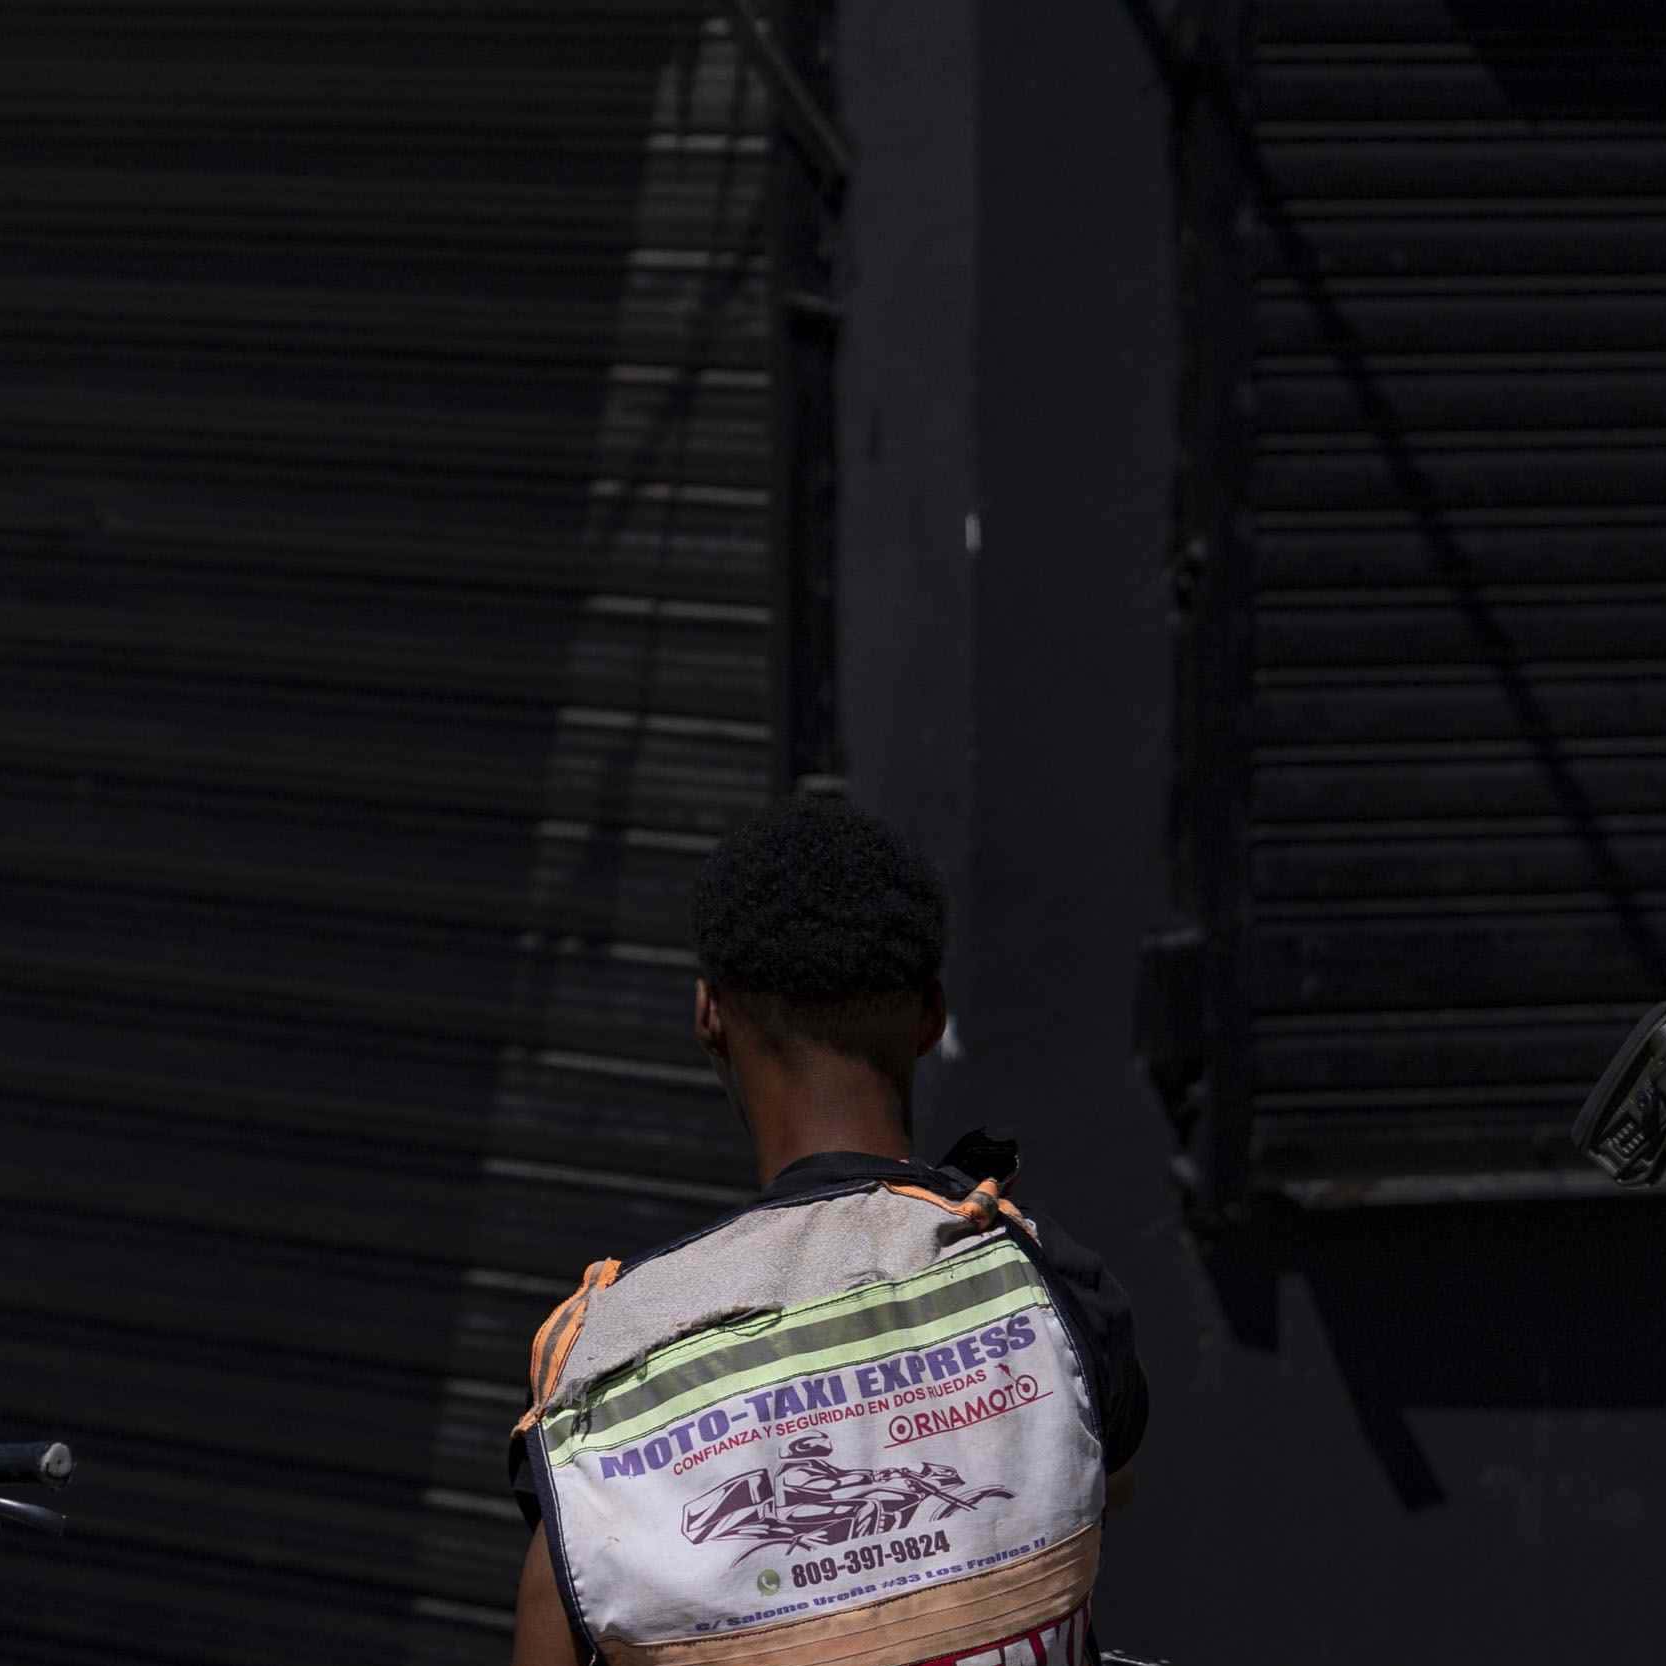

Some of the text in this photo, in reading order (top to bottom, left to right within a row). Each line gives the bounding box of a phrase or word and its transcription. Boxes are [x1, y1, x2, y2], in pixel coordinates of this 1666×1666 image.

[599, 1316, 1036, 1480] MOTO-TAXI EXPRESS
[673, 1370, 987, 1476] CONFIANZA Y SEGURIDAD EN DOS RUEDAS
[889, 1374, 1038, 1443] ORNAMOTO
[791, 1530, 950, 1588] 809-397-9824
